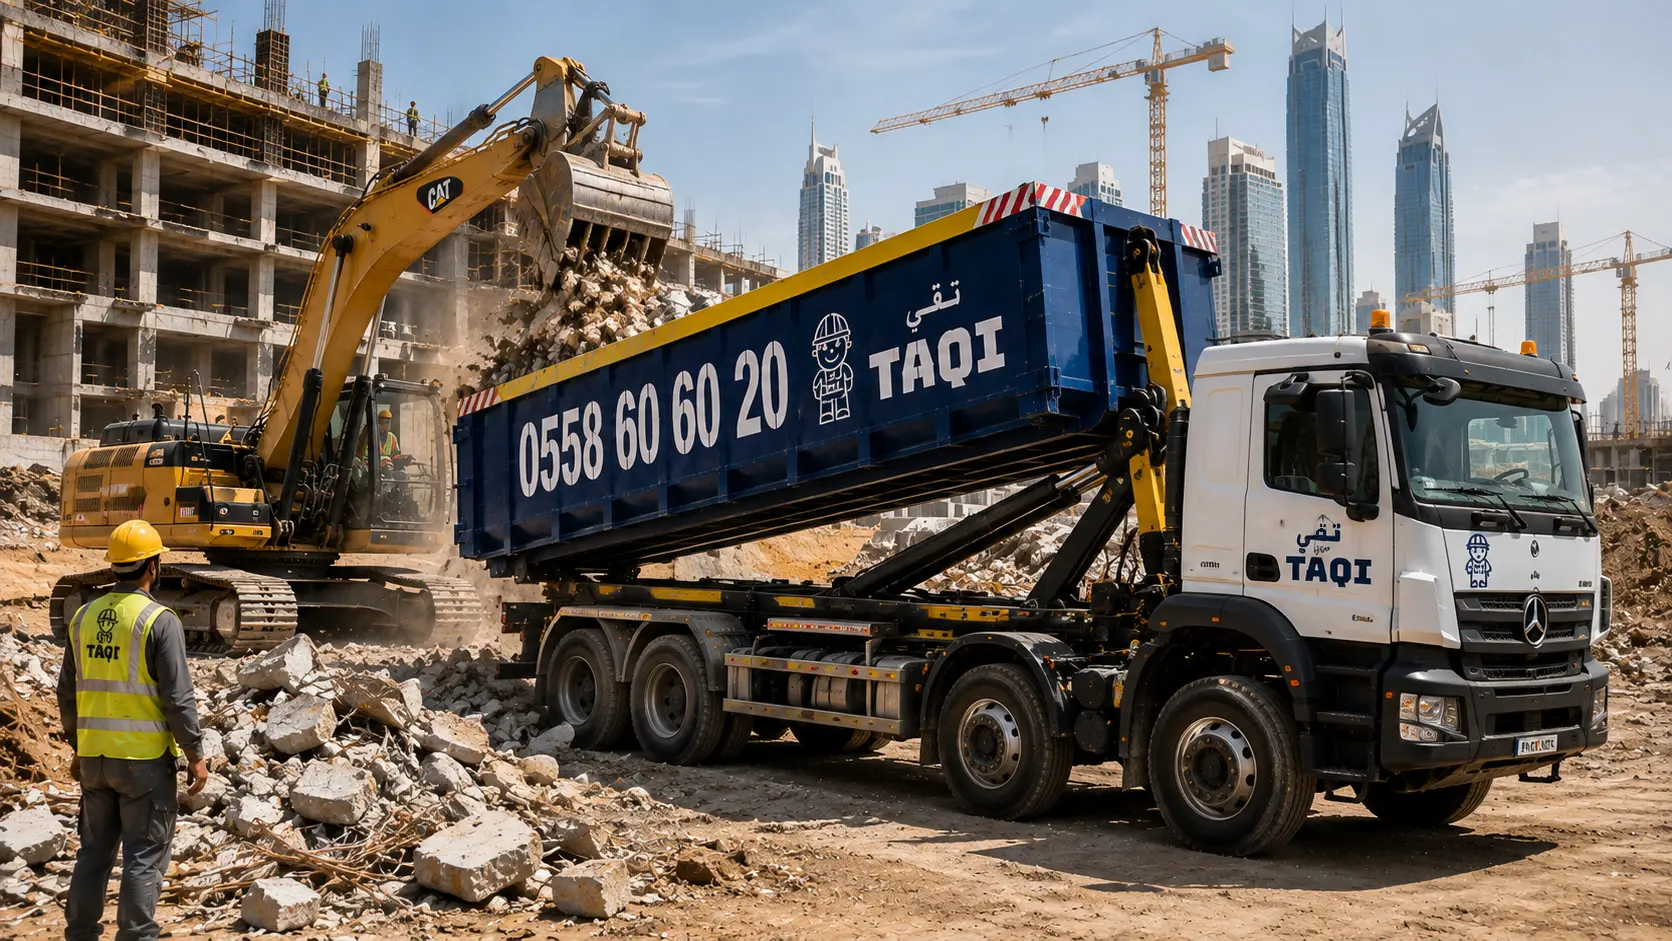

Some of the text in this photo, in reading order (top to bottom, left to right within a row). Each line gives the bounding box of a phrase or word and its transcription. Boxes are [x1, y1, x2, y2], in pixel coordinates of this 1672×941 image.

[428, 179, 450, 210] CAT
[906, 280, 960, 333] تقي
[869, 315, 1005, 400] TAQI
[519, 341, 788, 498] 0558 60 60 20
[1286, 556, 1372, 587] TAQI
[86, 644, 120, 663] TAQI
